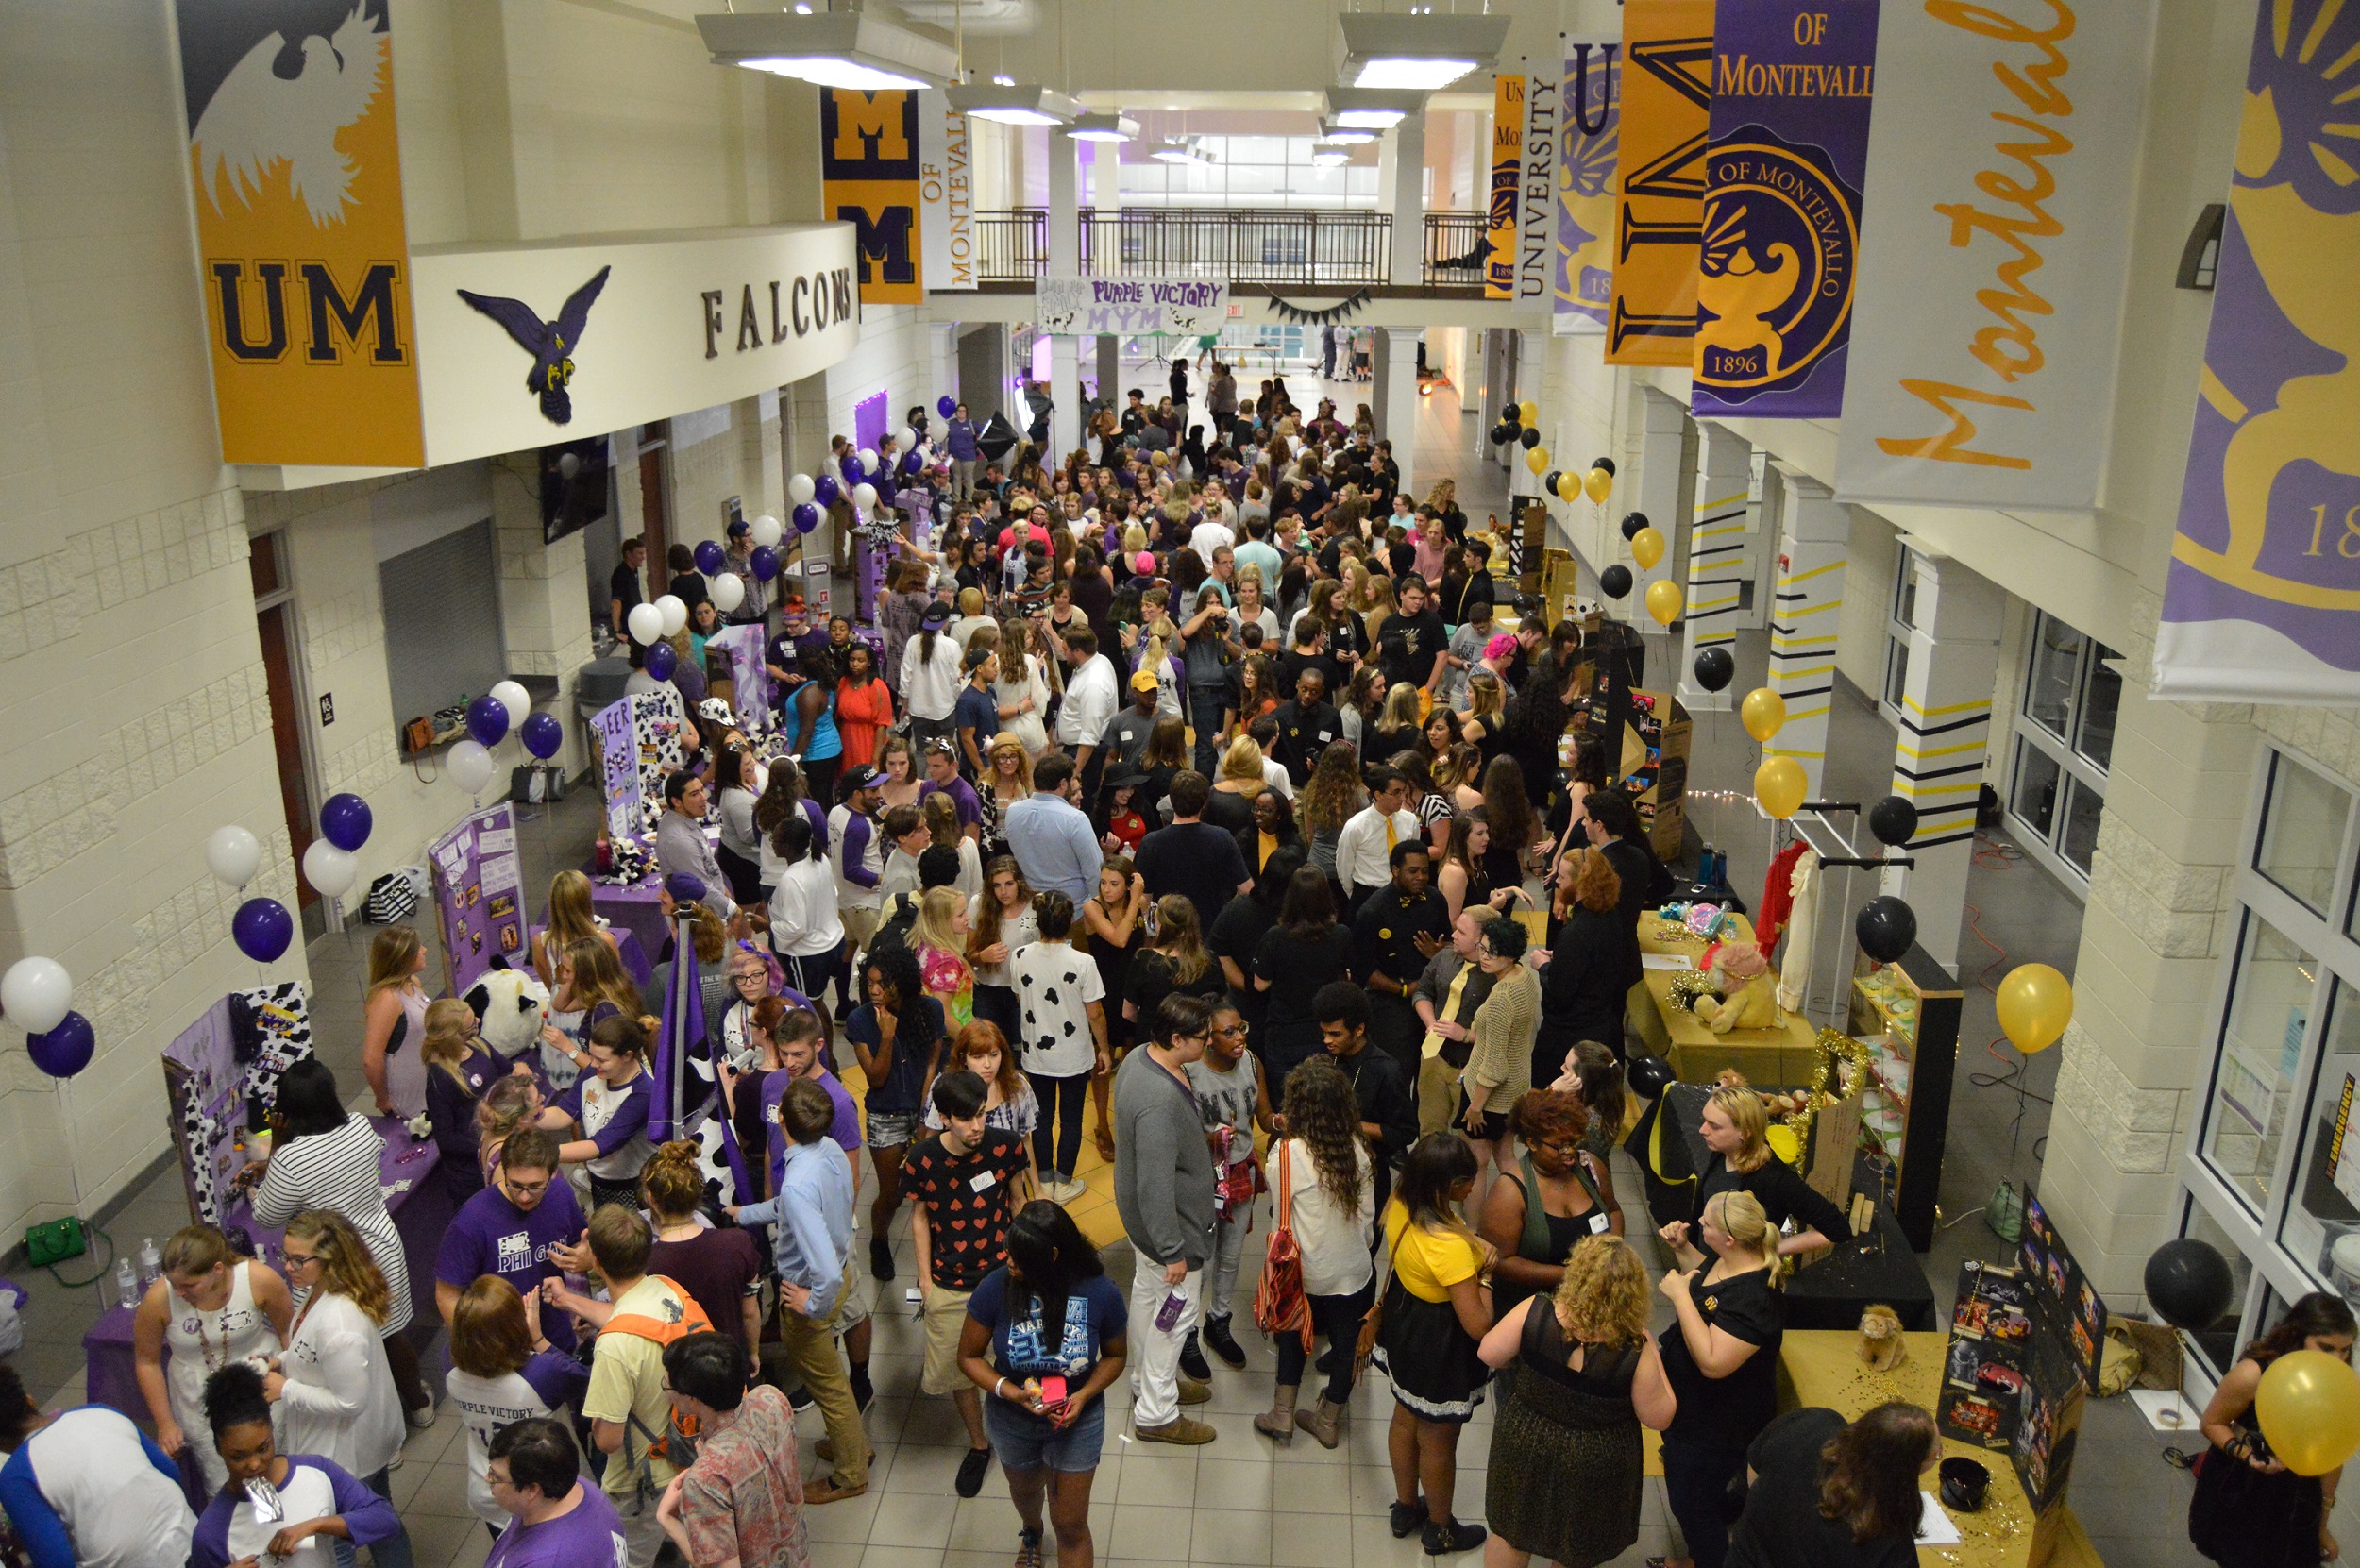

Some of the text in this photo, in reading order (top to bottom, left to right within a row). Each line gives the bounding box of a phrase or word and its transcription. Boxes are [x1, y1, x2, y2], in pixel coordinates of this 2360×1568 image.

[1794, 12, 1828, 46] OF
[833, 89, 909, 160] M
[921, 163, 942, 204] OF
[1521, 76, 1556, 299] UNIVERSITY
[837, 205, 915, 283] M
[1757, 163, 1844, 297] MONTEVALLO
[208, 258, 409, 366] UM
[701, 267, 851, 359] FALCONS
[1087, 305, 1162, 331] MYM
[1091, 280, 1223, 308] PURPLE VICTORY
[1714, 355, 1758, 374] 1896
[2329, 1077, 2354, 1163] EMERGENCY
[497, 1249, 532, 1273] PHI
